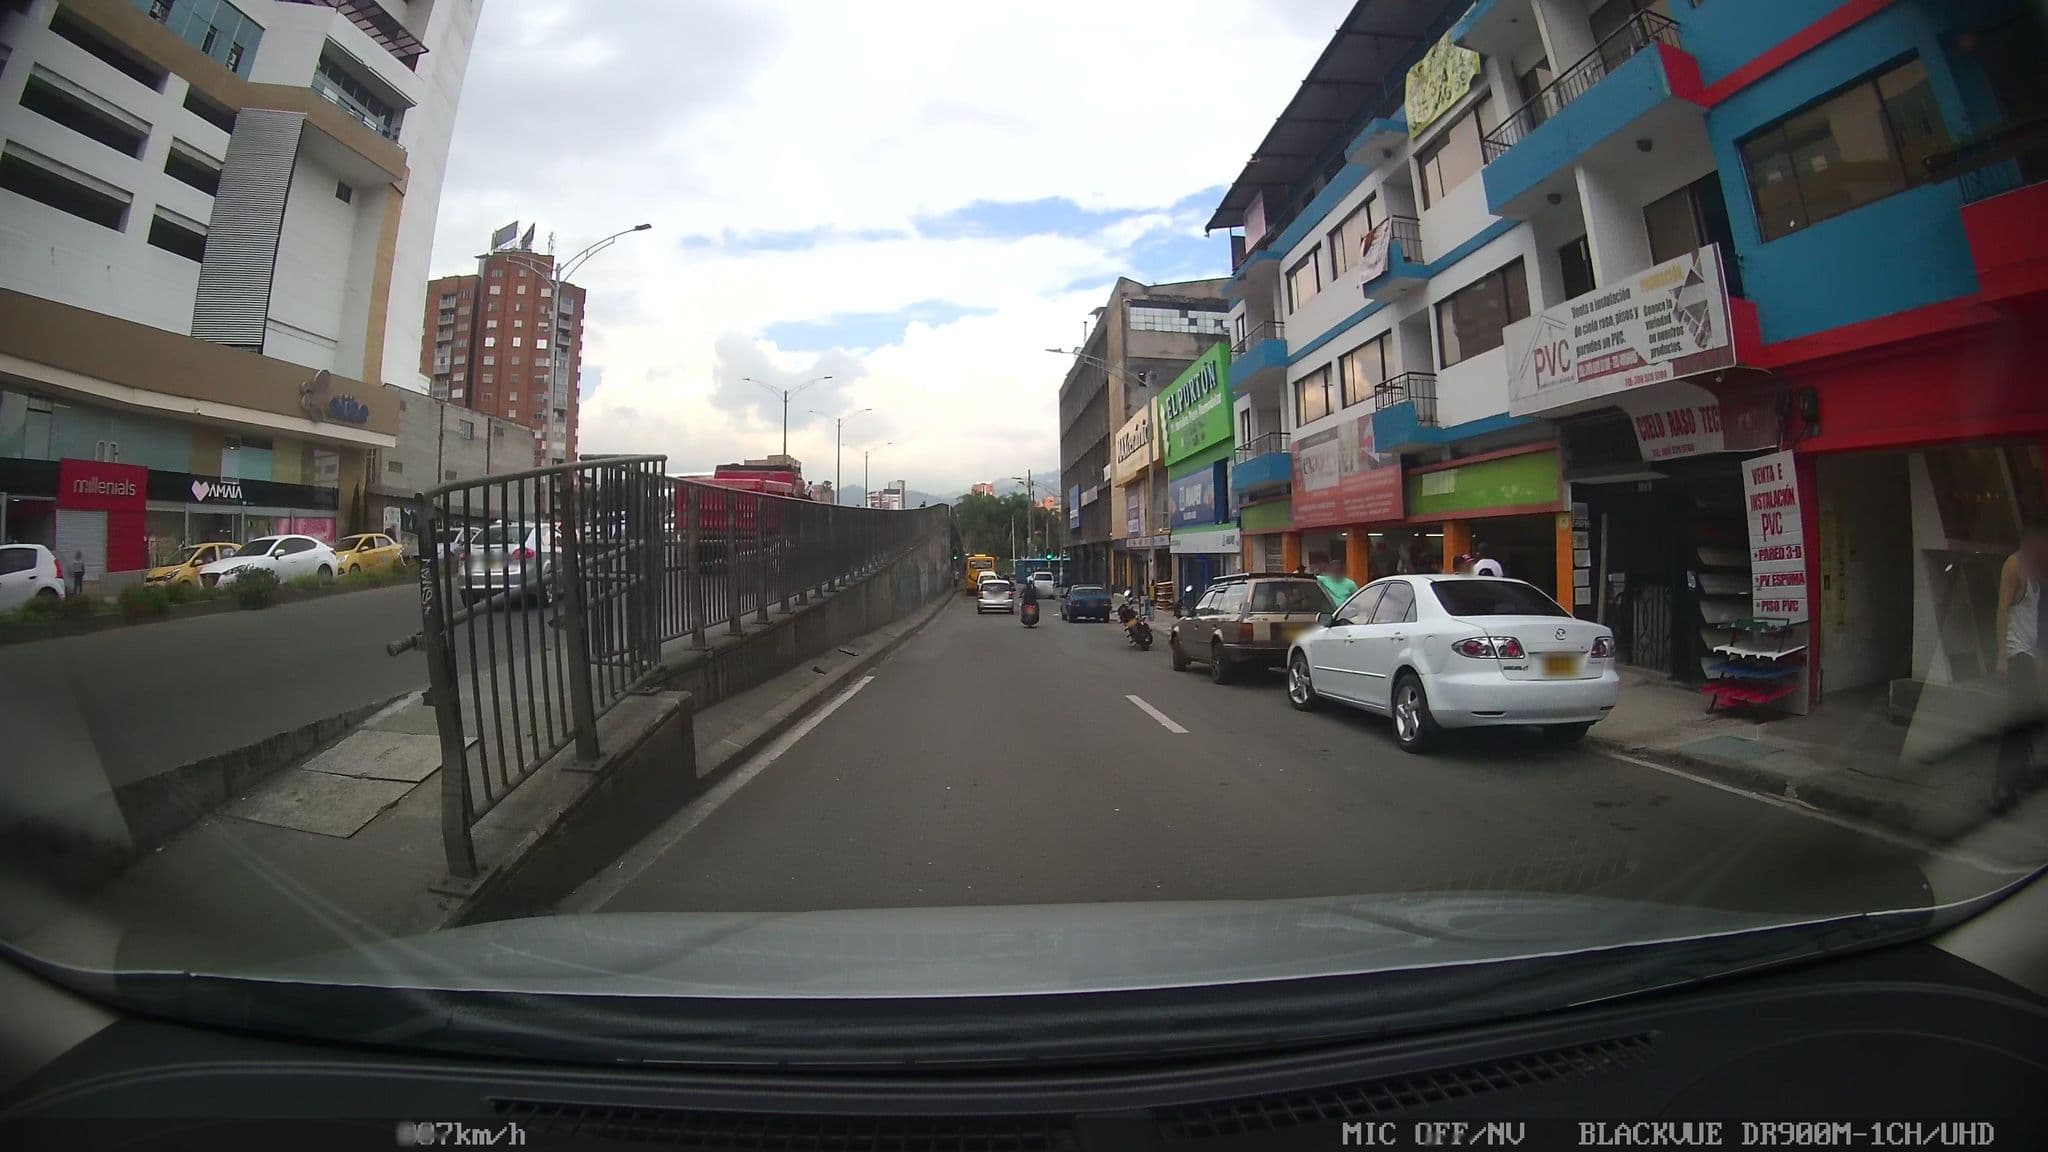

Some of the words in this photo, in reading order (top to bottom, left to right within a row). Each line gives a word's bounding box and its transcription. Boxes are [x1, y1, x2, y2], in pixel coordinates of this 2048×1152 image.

[1643, 301, 1666, 317] Conoce
[1583, 320, 1598, 335] cielo
[1615, 308, 1634, 325] pisos
[1657, 325, 1684, 341] nuestros
[1533, 338, 1571, 389] PVC
[1166, 394, 1179, 420] EL
[1178, 360, 1217, 414] PORTÓN
[1636, 414, 1666, 441] CIELO
[1667, 408, 1697, 437] RASO
[1752, 465, 1775, 486] VENTA
[1777, 463, 1783, 480] E
[73, 477, 136, 496] millenials
[1750, 484, 1796, 512] INSTALACIÓN
[1762, 511, 1783, 542] PVC
[1758, 548, 1786, 561] PARED
[1772, 572, 1805, 586] ESPUMA
[1761, 600, 1780, 613] PISO
[1782, 600, 1799, 612] PVC
